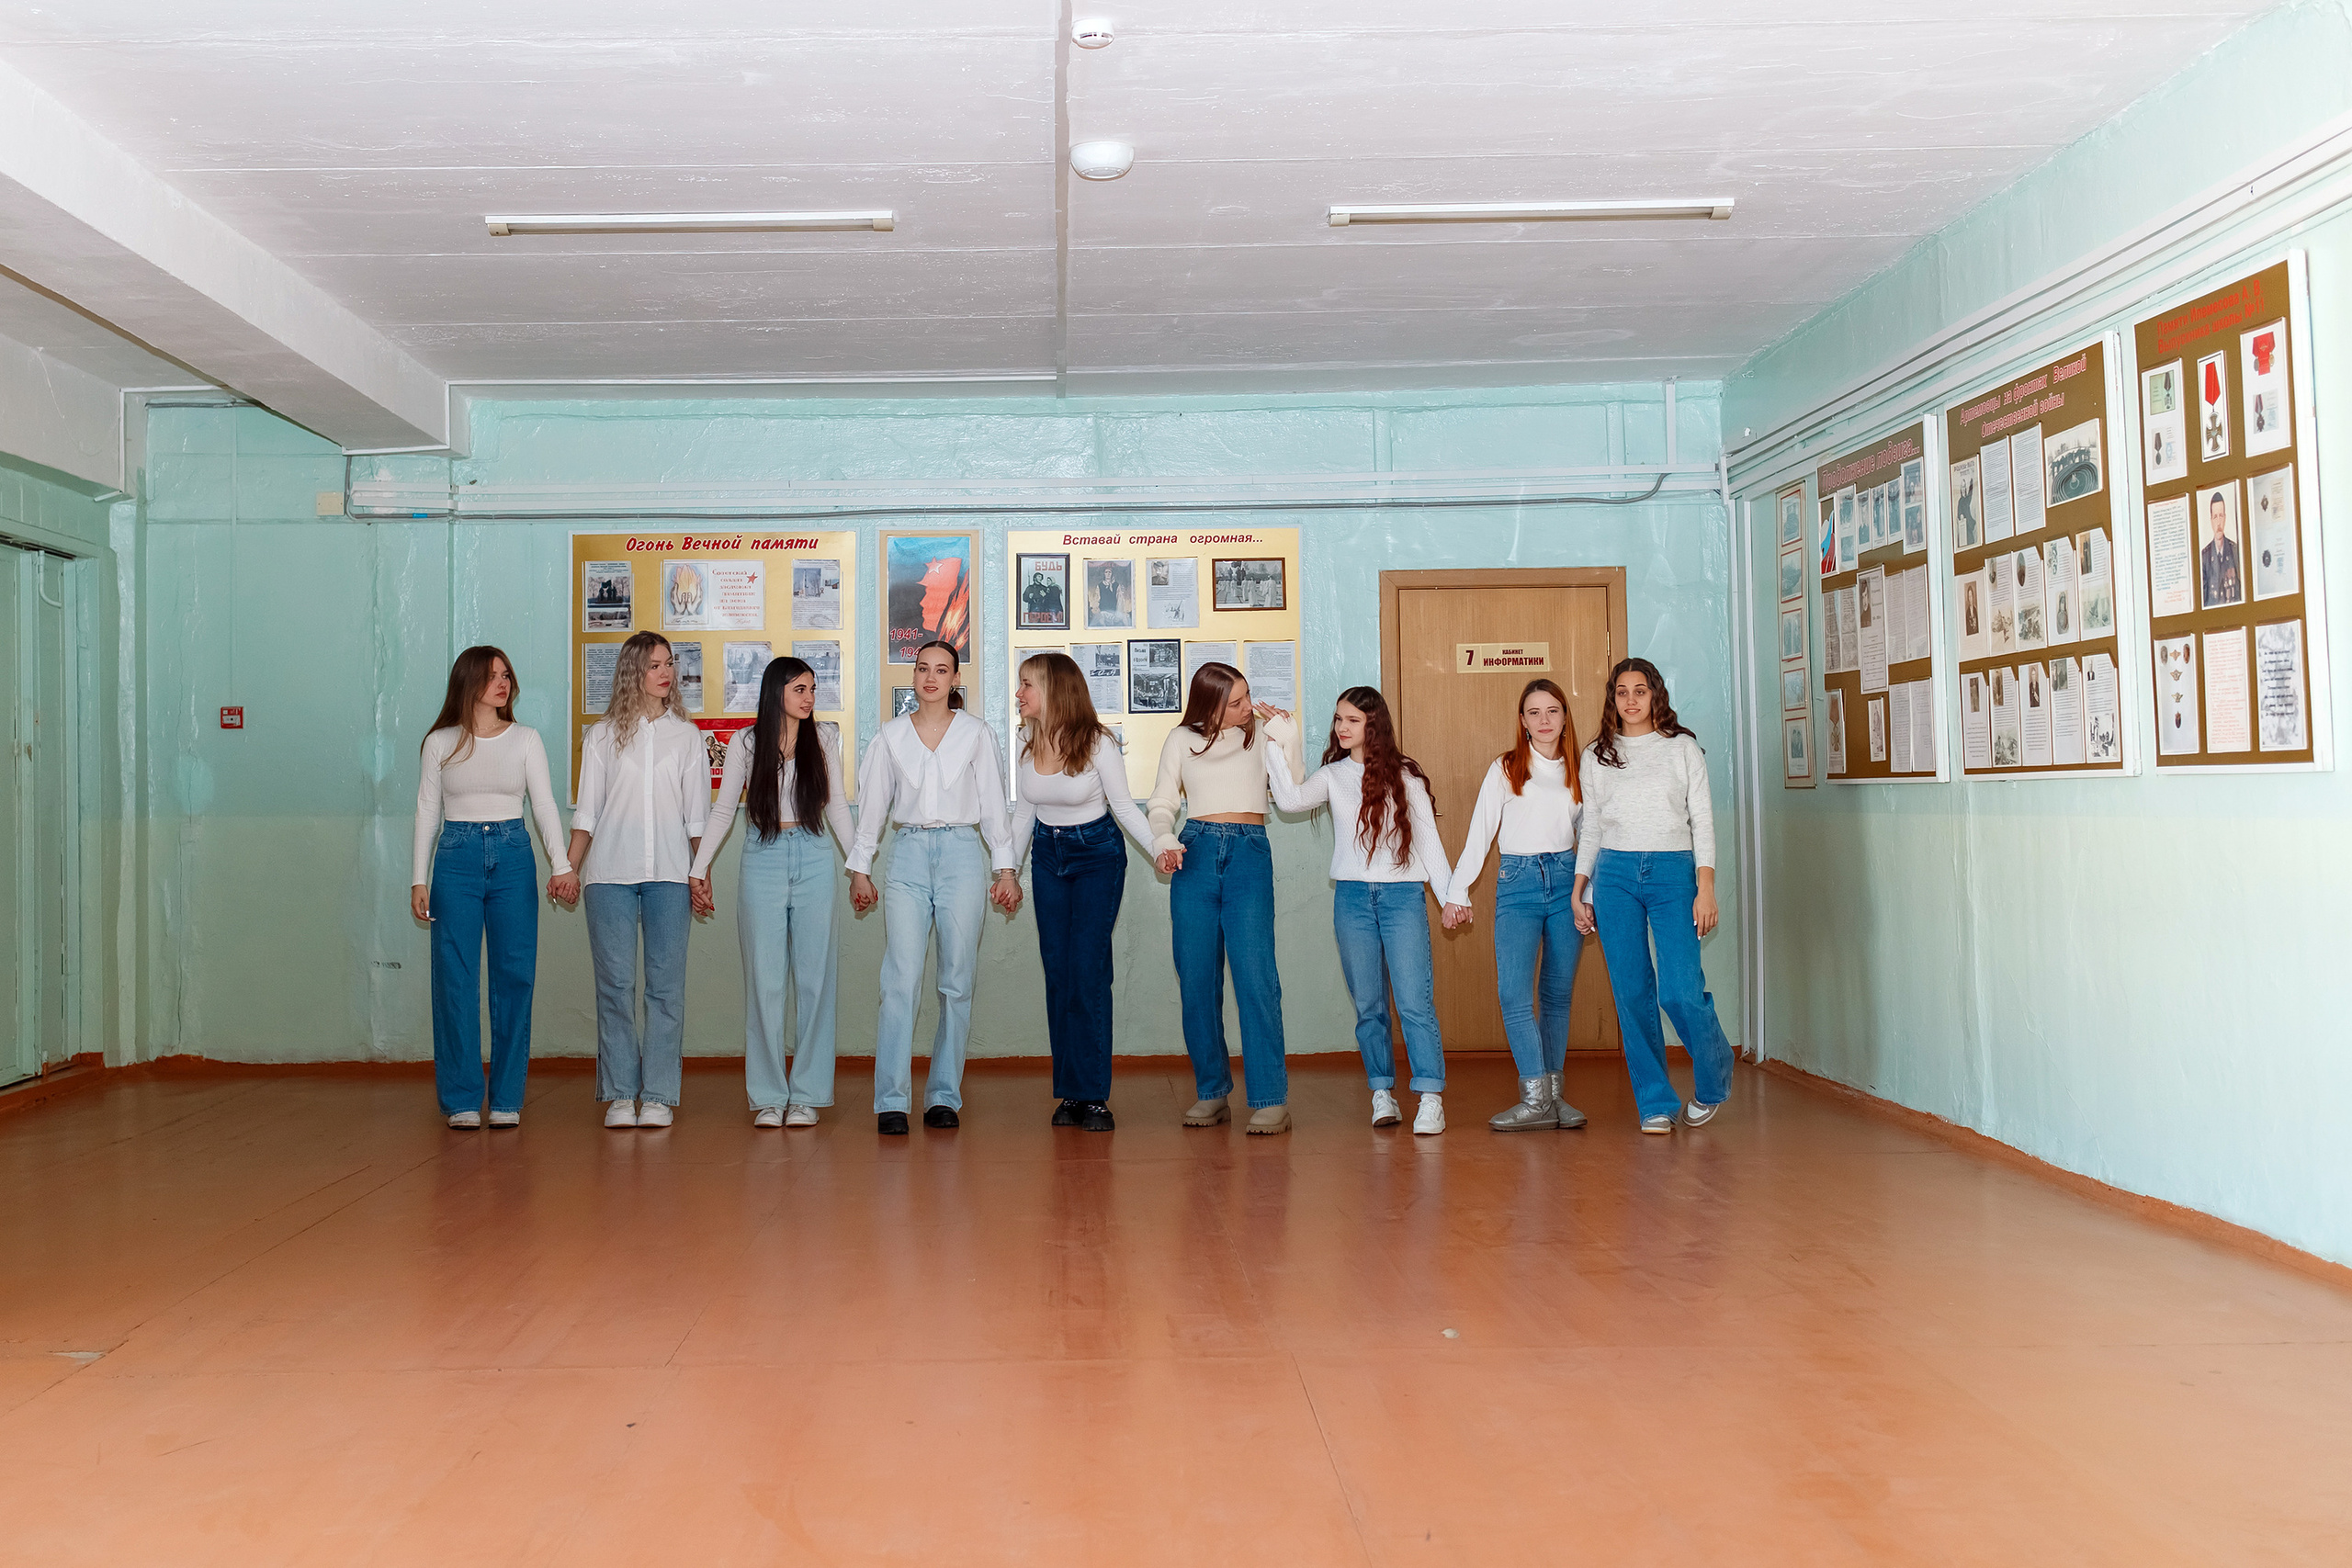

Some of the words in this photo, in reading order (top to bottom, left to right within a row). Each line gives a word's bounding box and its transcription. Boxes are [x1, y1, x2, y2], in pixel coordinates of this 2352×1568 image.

[2211, 311, 2243, 333] школы
[2003, 389, 2013, 405] на
[2013, 374, 2048, 404] фронтах
[2052, 353, 2087, 384] Великой
[1981, 398, 2039, 438] Отечественной
[2039, 392, 2064, 414] войны
[1822, 455, 1875, 492] Продолжение
[626, 536, 674, 551] Огонь
[682, 535, 743, 551] Вечной
[750, 538, 820, 550] памяти
[1062, 534, 1122, 546] Вставай
[1128, 535, 1178, 546] страна
[1189, 534, 1263, 546] огромная...
[1035, 561, 1062, 570] БУДЬ
[890, 628, 923, 640] 1941-
[899, 647, 922, 658] 194
[1465, 649, 1474, 665] 7
[1483, 657, 1544, 666] ИНФОРМАТИКИ
